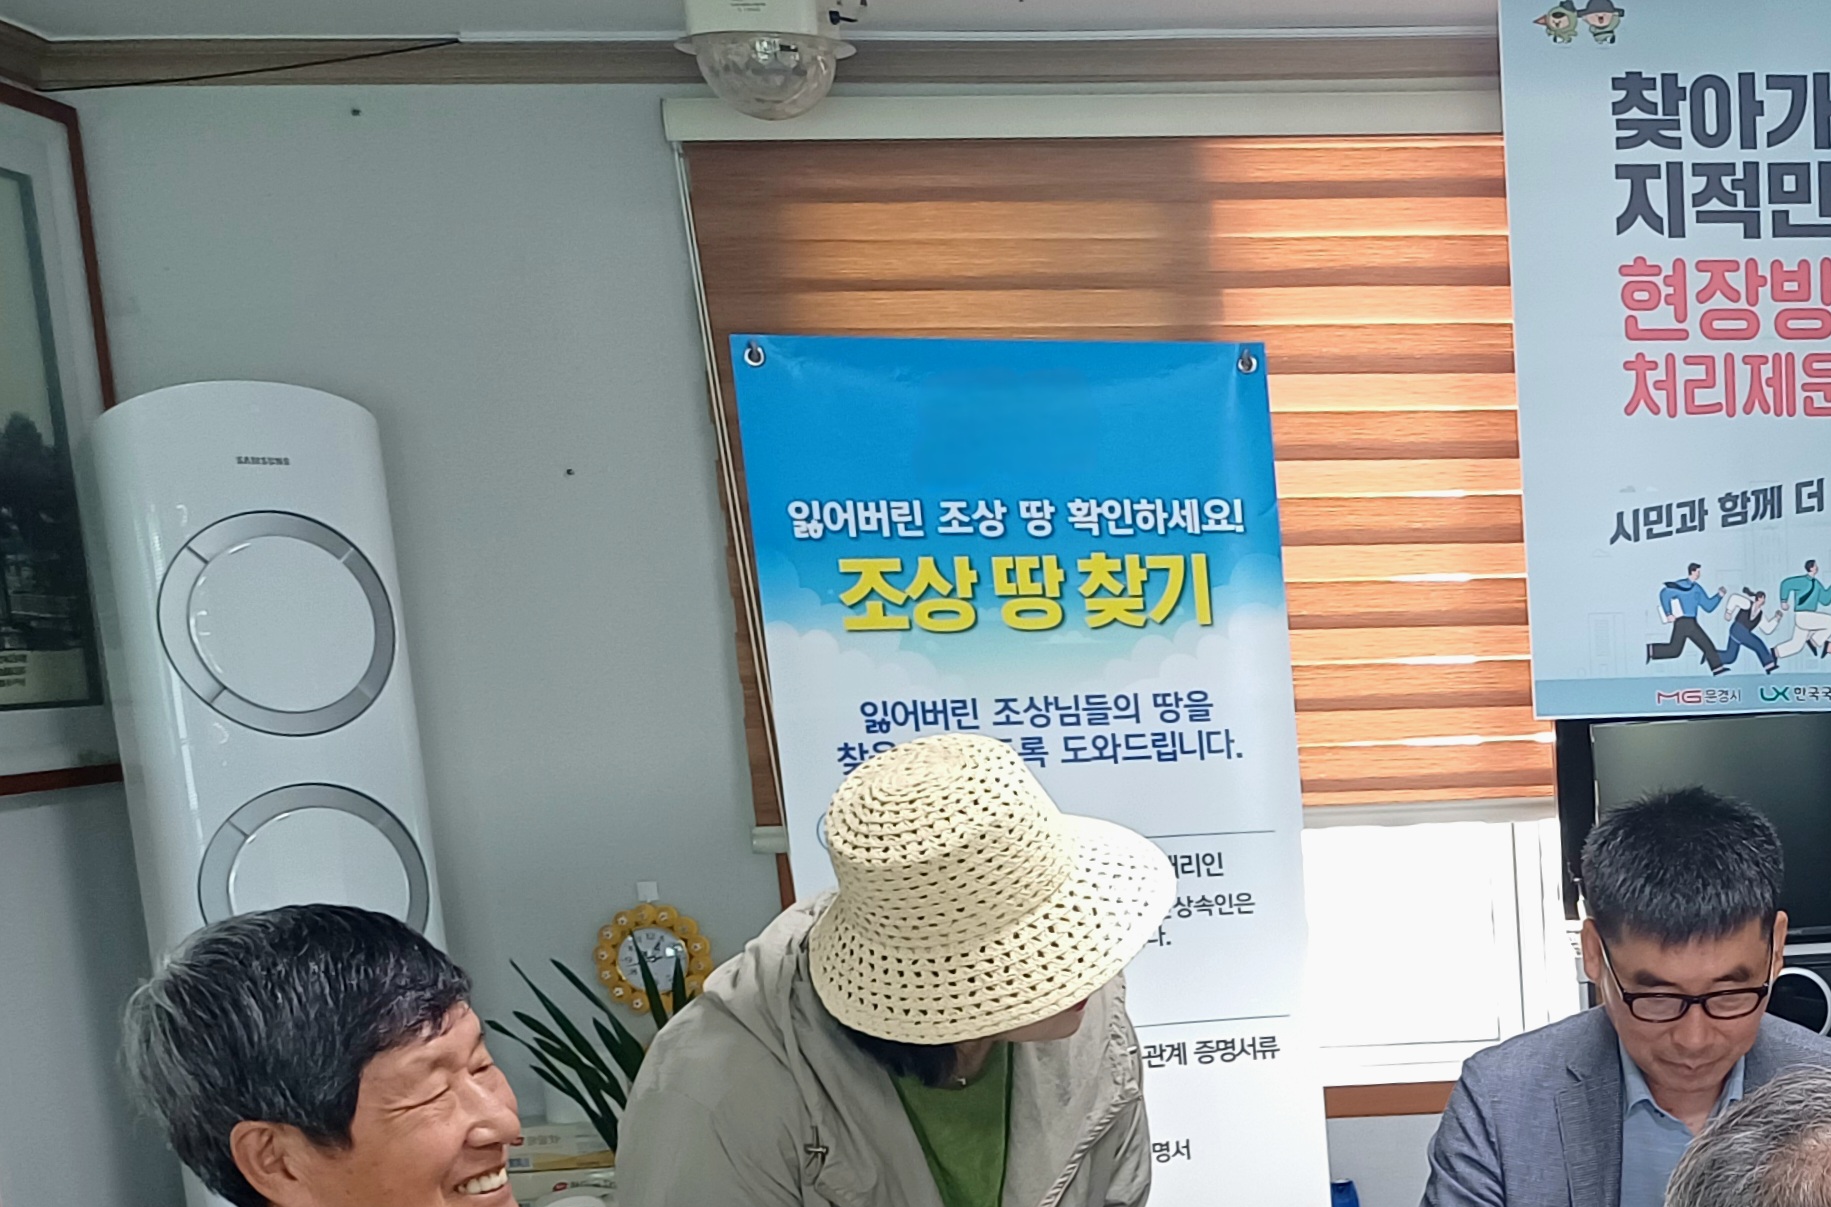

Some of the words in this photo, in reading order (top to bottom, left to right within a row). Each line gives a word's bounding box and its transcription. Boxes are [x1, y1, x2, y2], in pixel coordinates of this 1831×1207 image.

[787, 499, 925, 539] 잃어버린
[938, 499, 1006, 537] 조상
[1019, 499, 1055, 537] 땅
[1067, 498, 1245, 536] 확인하세요!
[1609, 497, 1708, 545] 시민과
[1717, 484, 1783, 528] 함께
[1794, 476, 1824, 515] 더
[837, 556, 978, 632] 조상
[988, 556, 1064, 631] 땅
[1075, 553, 1213, 629] 찾기
[859, 698, 980, 734] 잃어버린
[992, 692, 1142, 728] 조상님들의
[1152, 689, 1214, 723] 땅을
[1657, 690, 1702, 704] MG
[1705, 689, 1742, 702] 문경시
[1060, 728, 1243, 765] 도와드립니다.
[1173, 892, 1255, 919] 상속인은
[1141, 1042, 1188, 1068] 관계
[1193, 1036, 1280, 1065] 증명서류
[1152, 1139, 1192, 1163] 명서
